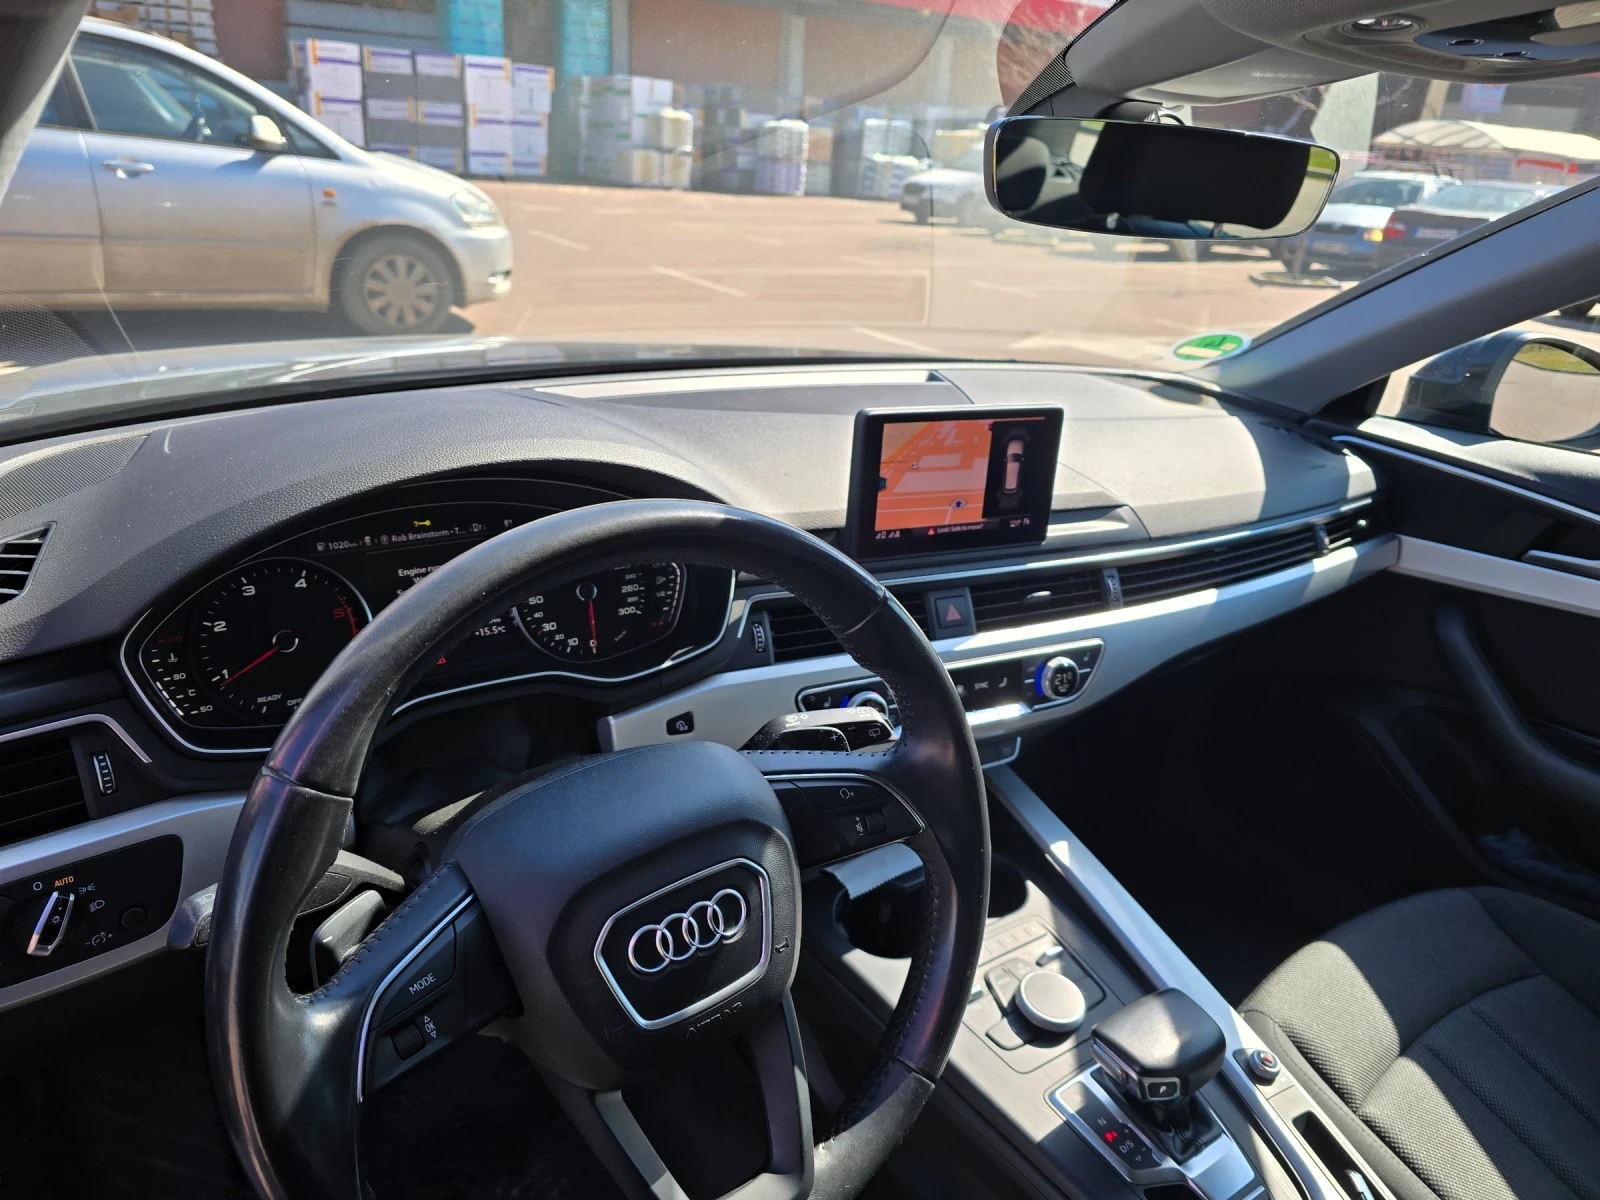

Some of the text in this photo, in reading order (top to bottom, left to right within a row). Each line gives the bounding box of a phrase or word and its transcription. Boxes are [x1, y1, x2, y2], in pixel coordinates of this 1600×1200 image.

[391, 534, 408, 542] Rob
[408, 529, 449, 541] Brainstorm
[398, 567, 427, 577] Engine
[294, 578, 308, 588] 4
[241, 585, 256, 596] 3
[621, 584, 639, 593] 260
[528, 595, 544, 605] 50
[333, 608, 345, 618] 5
[618, 606, 636, 616] 300
[213, 621, 227, 632] 2
[542, 622, 557, 632] 30
[554, 633, 565, 641] 20
[567, 637, 579, 646] 10
[173, 672, 186, 681] 90
[221, 669, 229, 679] 1
[257, 693, 282, 703] READY
[54, 875, 75, 888] AUTO
[408, 972, 437, 995] MODE
[424, 1020, 436, 1033] OK
[1119, 1139, 1136, 1154] D/S
